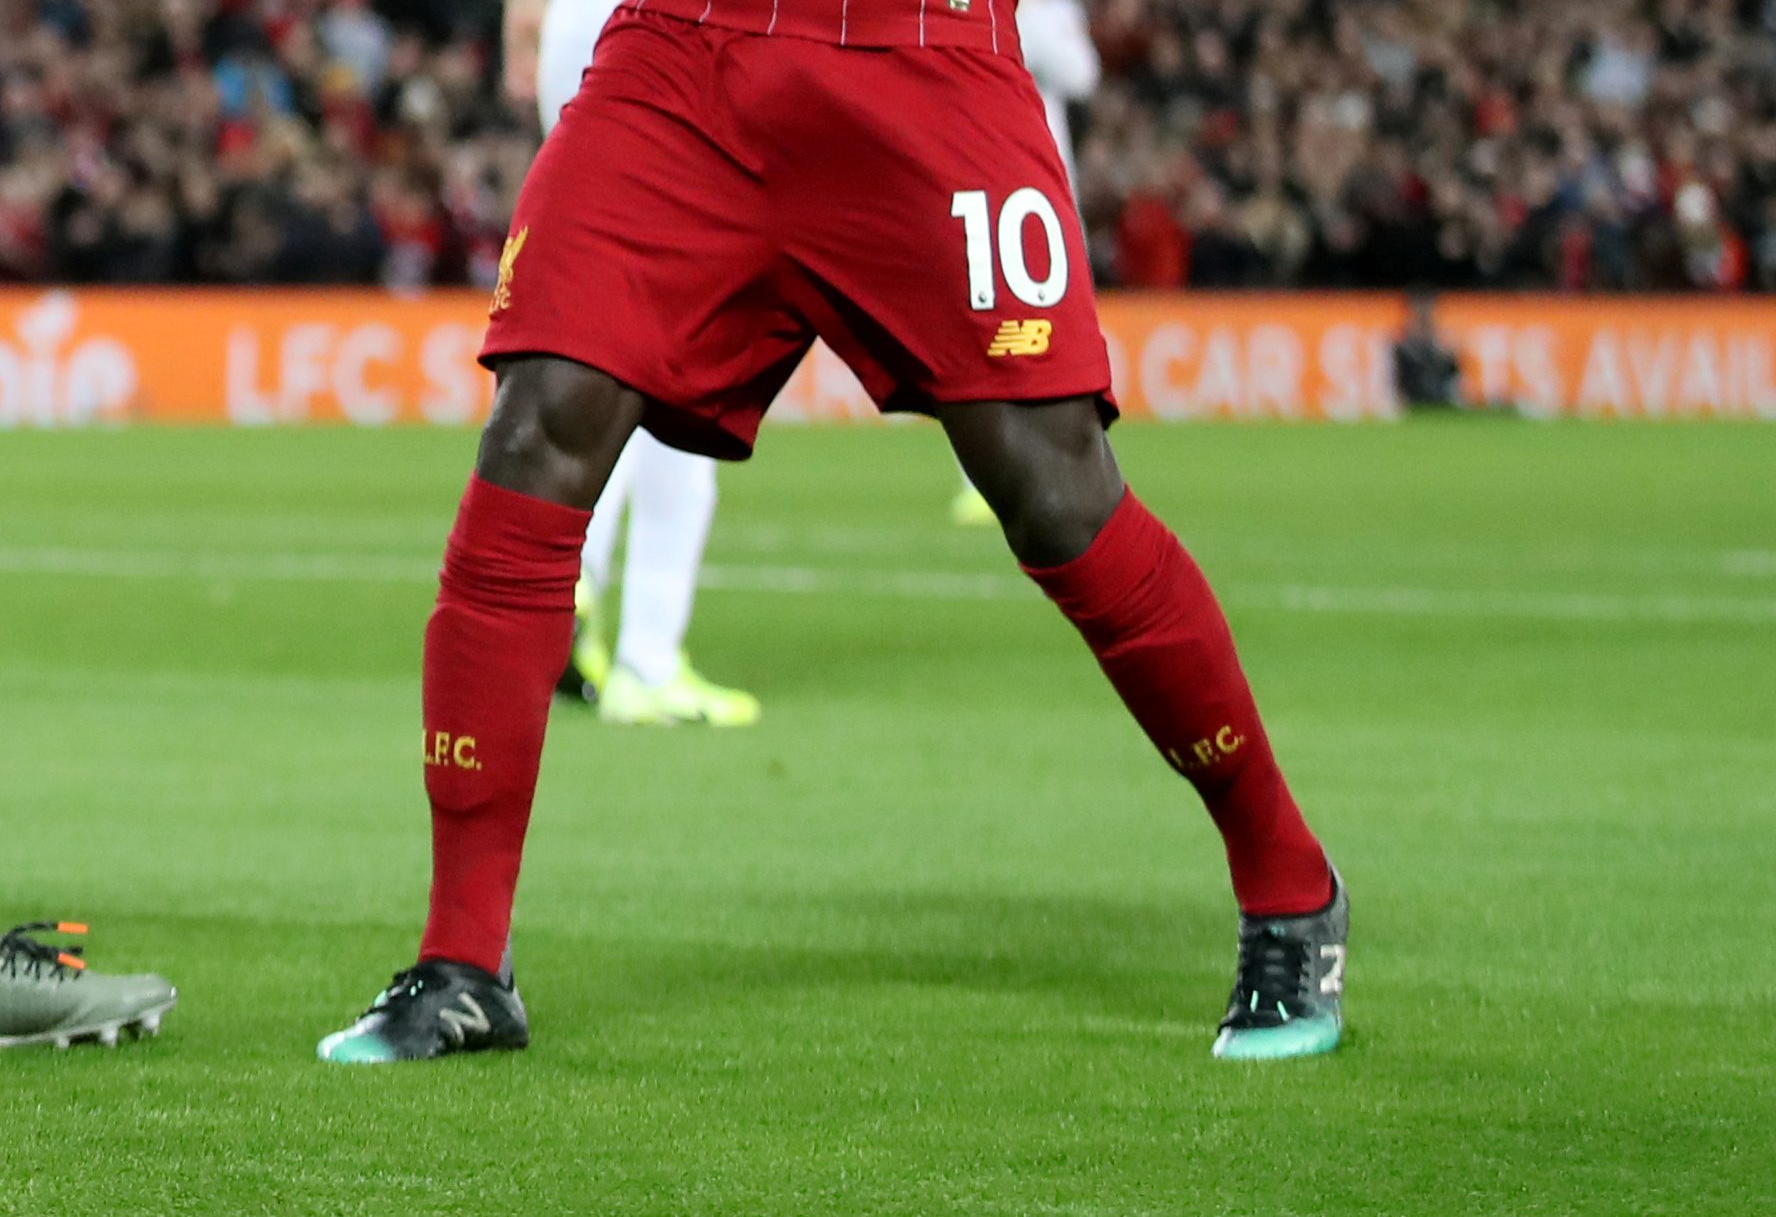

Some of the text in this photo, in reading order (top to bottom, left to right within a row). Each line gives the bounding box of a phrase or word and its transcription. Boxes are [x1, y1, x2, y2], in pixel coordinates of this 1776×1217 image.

[950, 187, 1069, 311] 10
[225, 322, 401, 425] LFC
[1140, 322, 1304, 424] CAR
